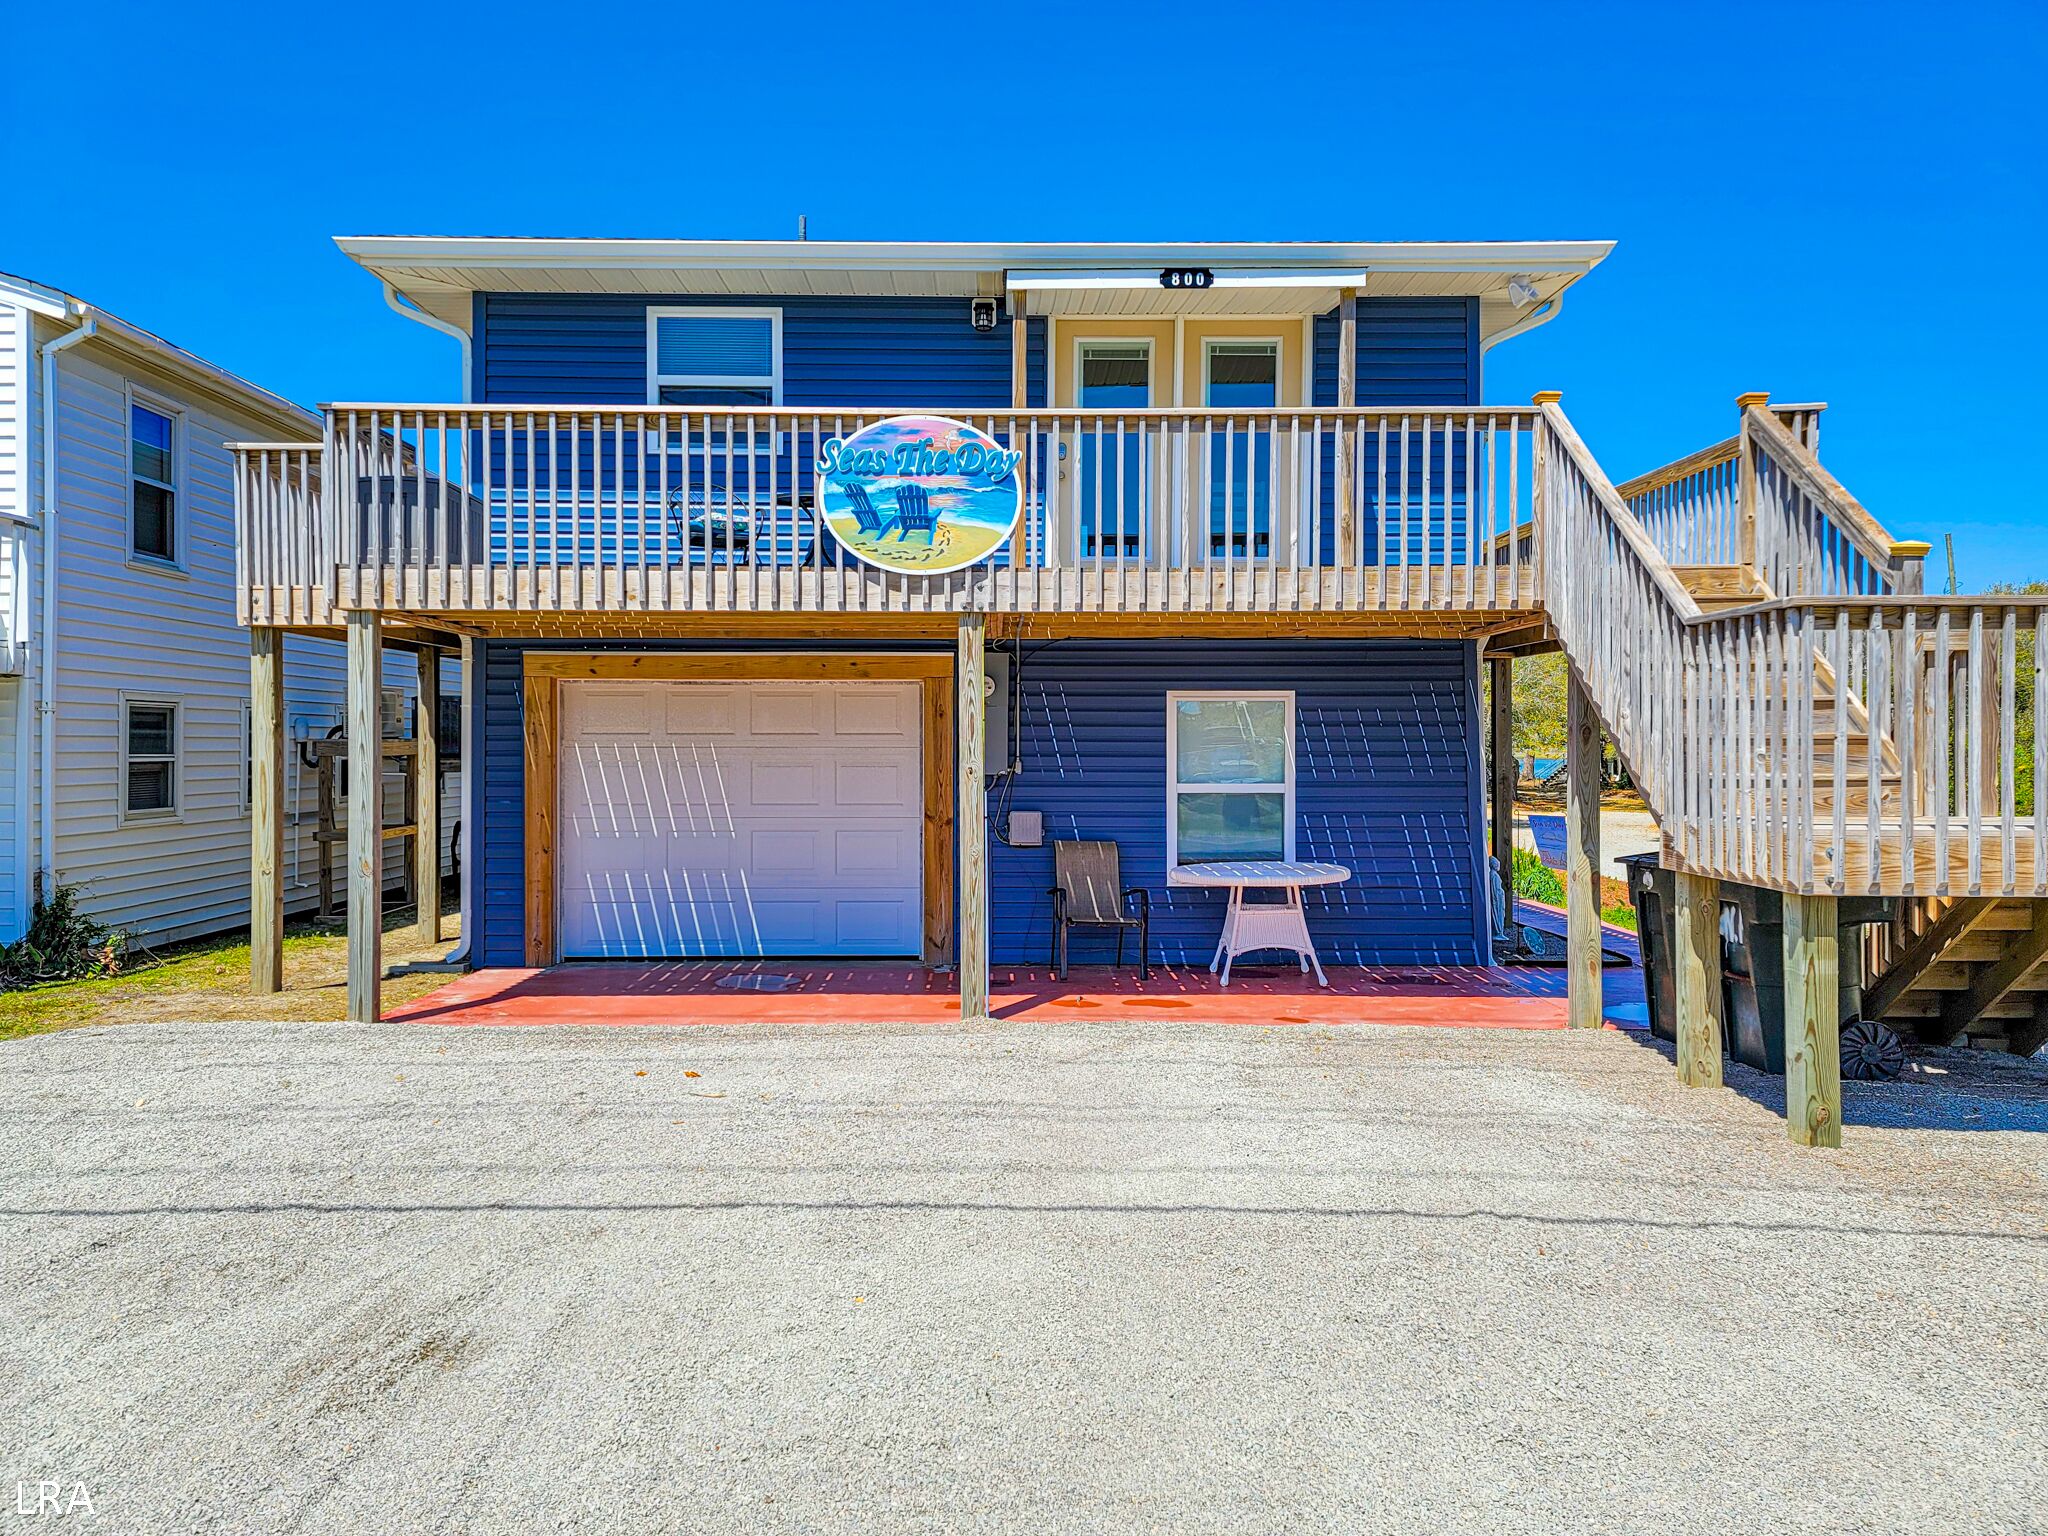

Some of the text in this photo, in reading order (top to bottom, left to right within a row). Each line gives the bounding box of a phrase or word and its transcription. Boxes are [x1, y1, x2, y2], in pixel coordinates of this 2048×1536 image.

[1171, 272, 1205, 286] 800
[815, 437, 1022, 481] Seas The Day
